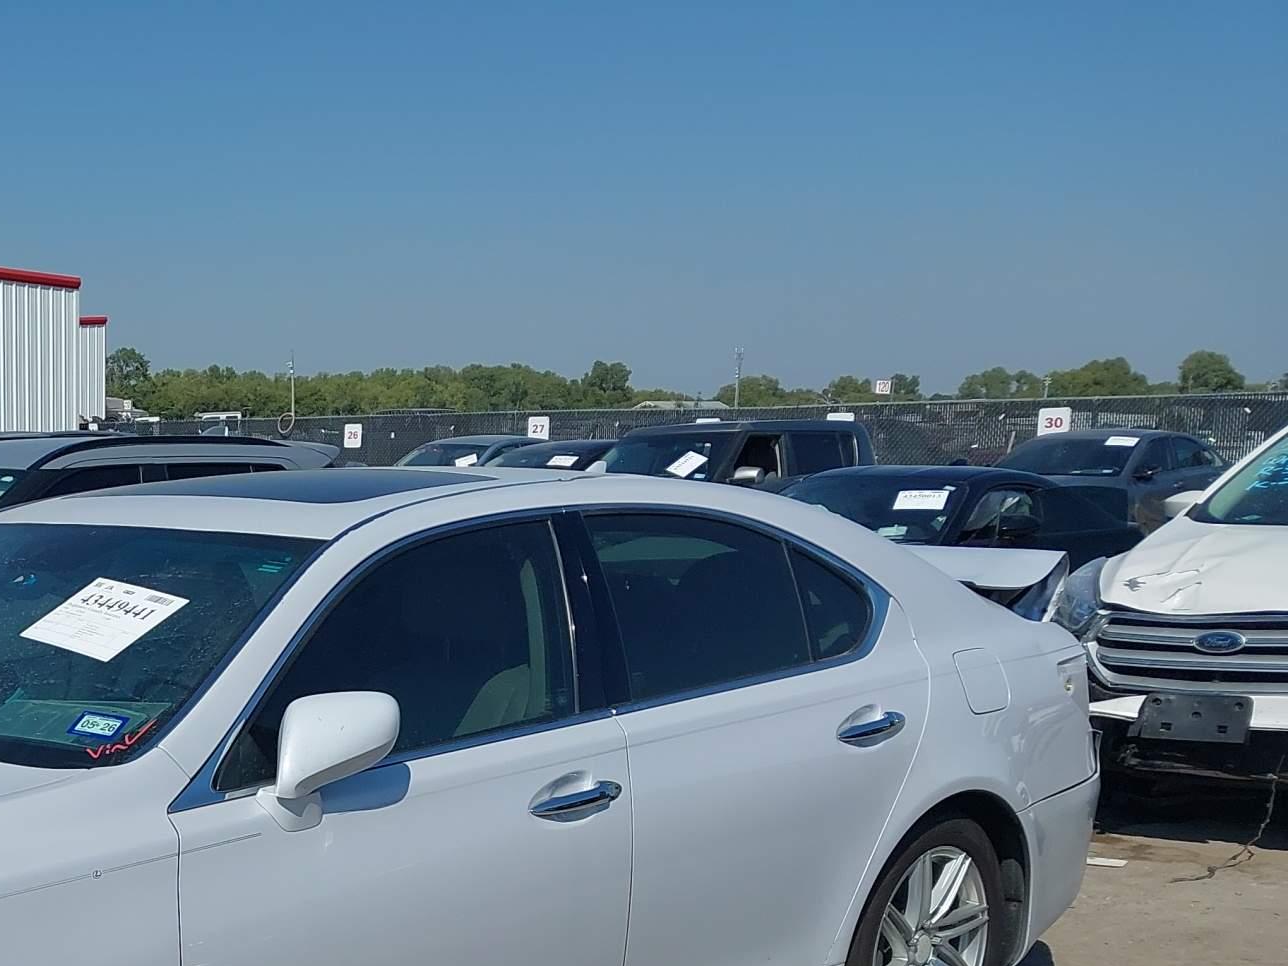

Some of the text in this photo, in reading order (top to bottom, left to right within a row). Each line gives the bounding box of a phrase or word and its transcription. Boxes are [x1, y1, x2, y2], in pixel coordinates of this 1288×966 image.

[878, 381, 889, 392] 120
[1044, 417, 1063, 429] 30
[532, 424, 545, 434] 27
[347, 431, 359, 440] 26
[80, 592, 158, 621] 43449441
[80, 719, 117, 732] 05 26
